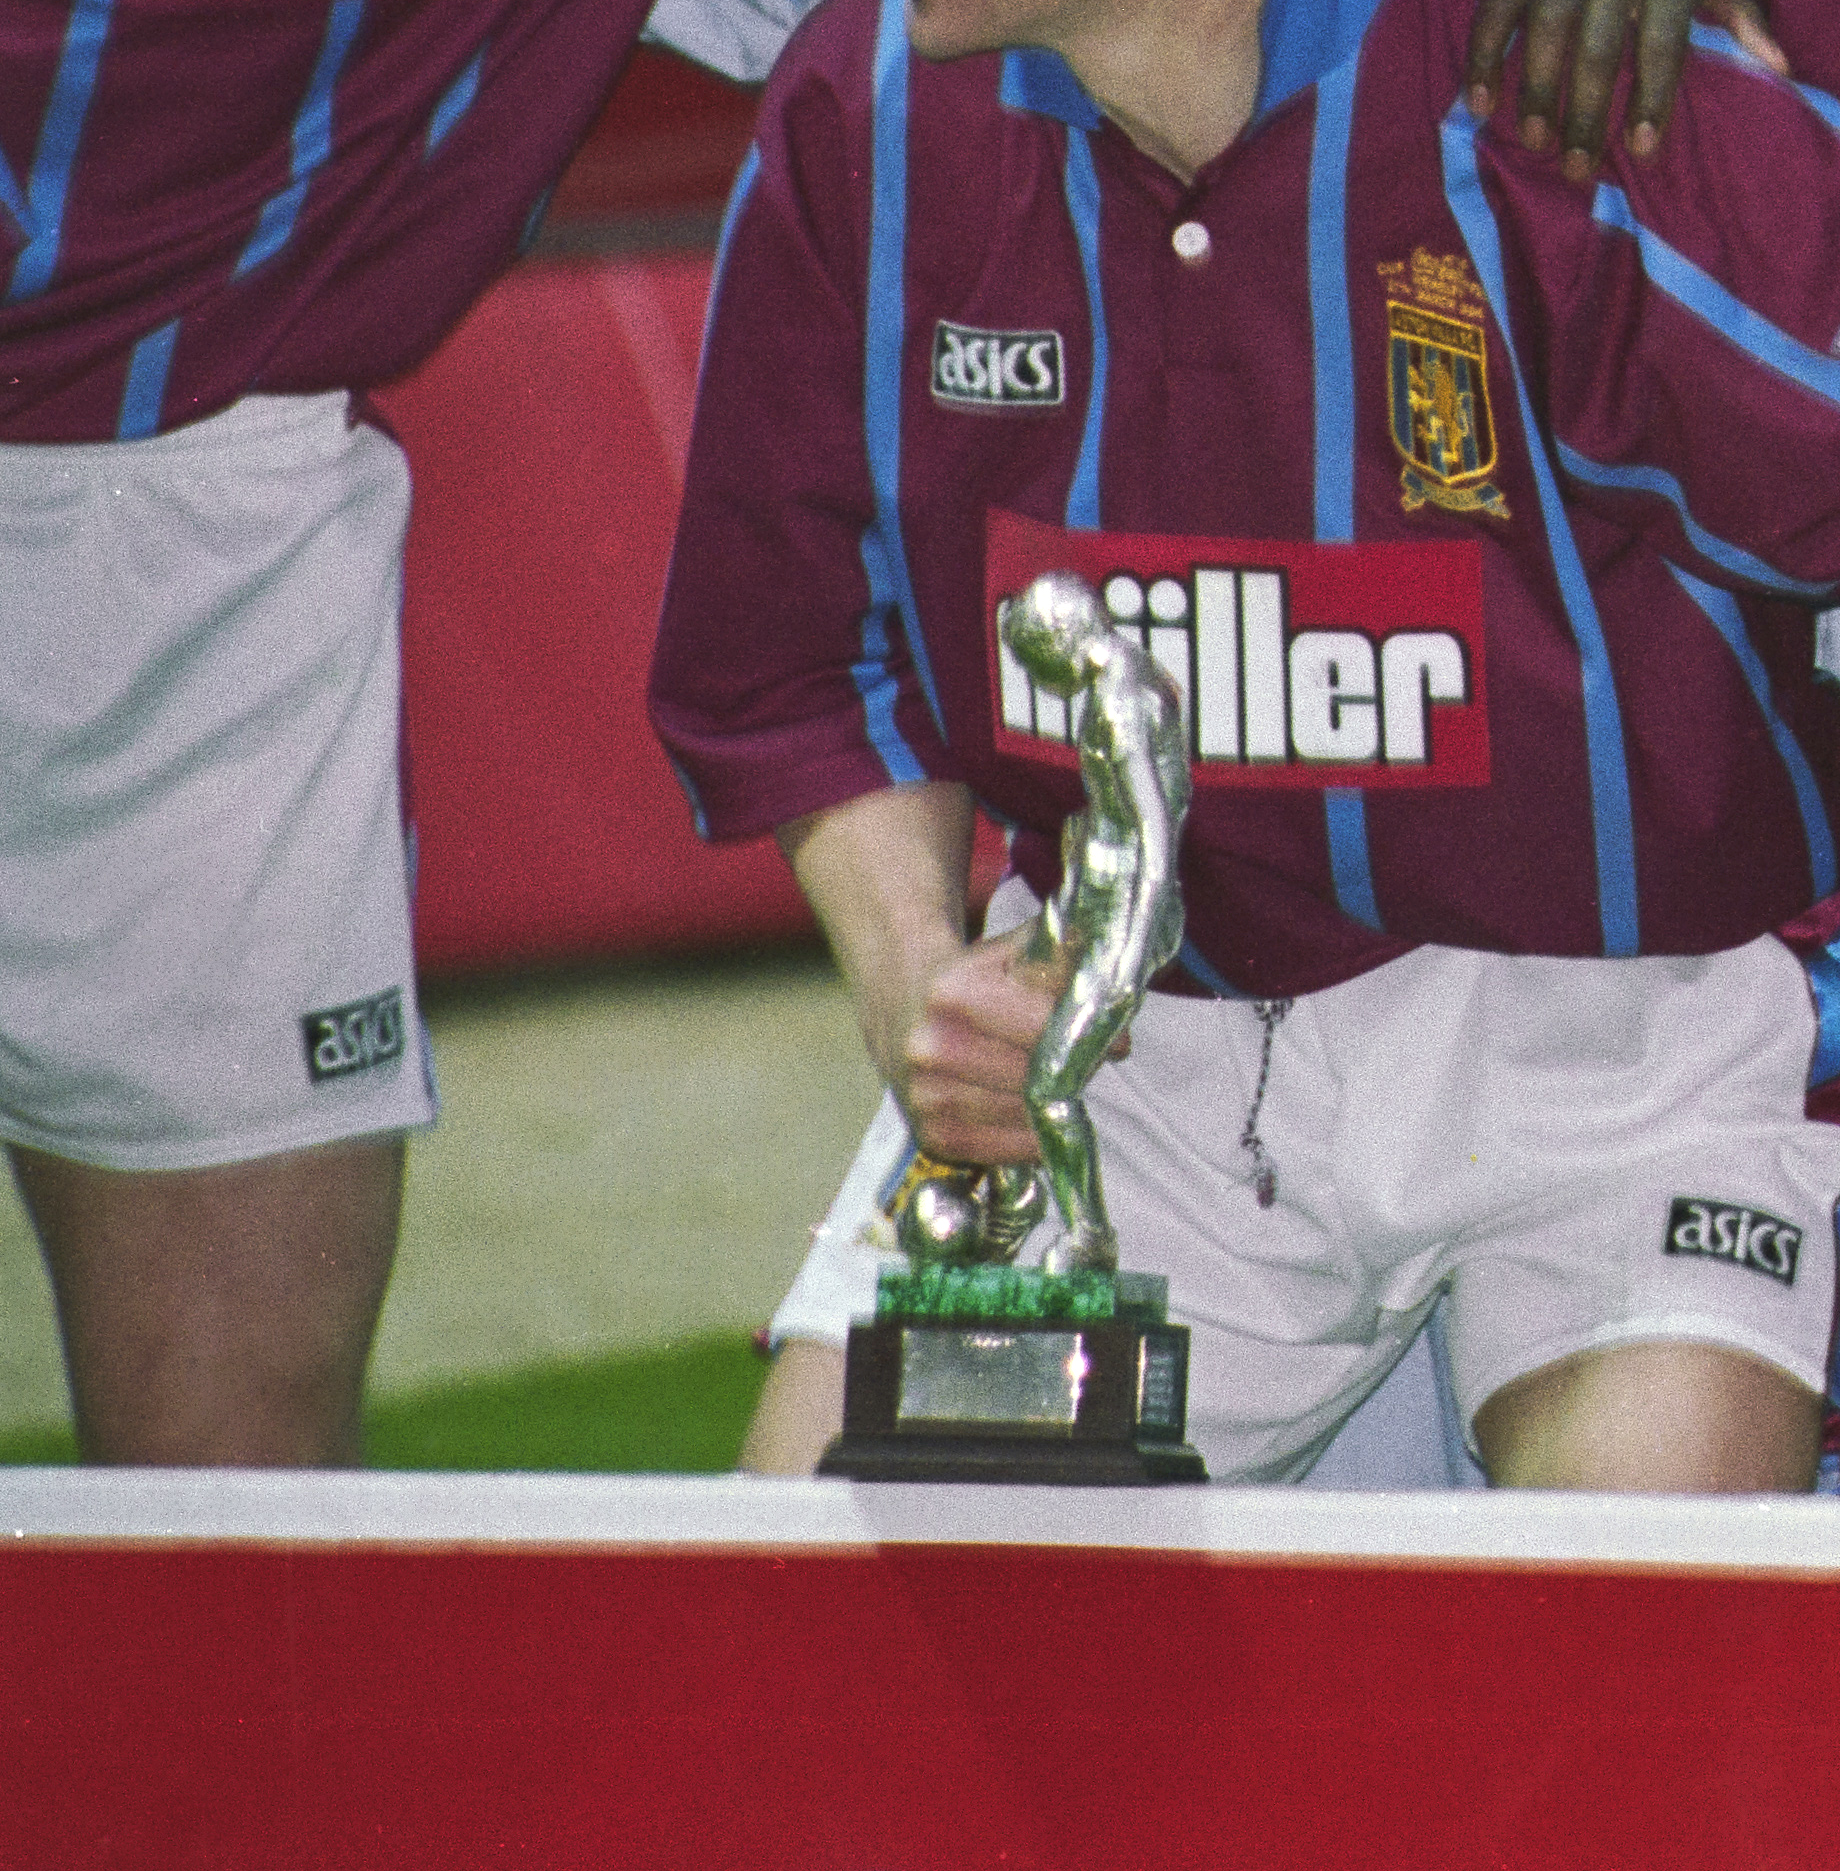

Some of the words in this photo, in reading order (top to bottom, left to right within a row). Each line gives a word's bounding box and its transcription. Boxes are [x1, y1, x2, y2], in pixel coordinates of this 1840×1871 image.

[941, 335, 1052, 396] asics
[313, 1000, 399, 1070] asics
[1674, 1204, 1798, 1275] asics
